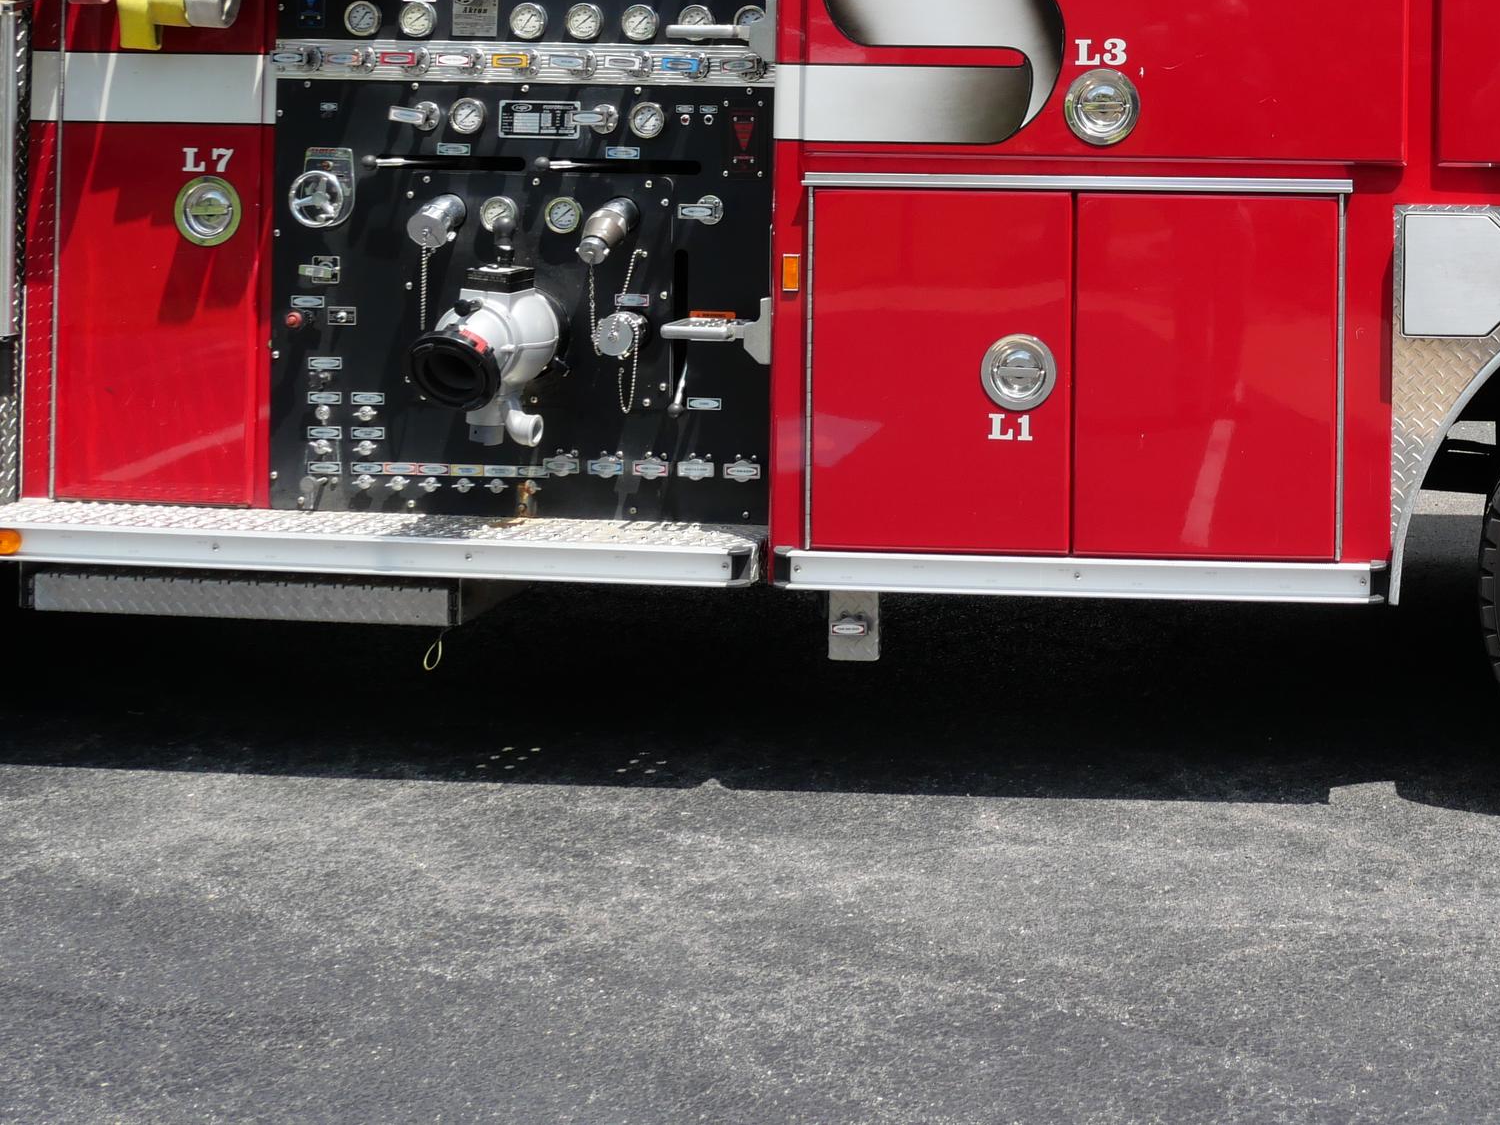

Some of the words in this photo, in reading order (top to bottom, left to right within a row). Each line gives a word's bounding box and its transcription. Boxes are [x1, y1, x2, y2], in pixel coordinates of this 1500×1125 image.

[461, 6, 489, 14] Akron
[1074, 38, 1127, 66] L3
[182, 147, 234, 172] L7
[987, 413, 1033, 441] L1
